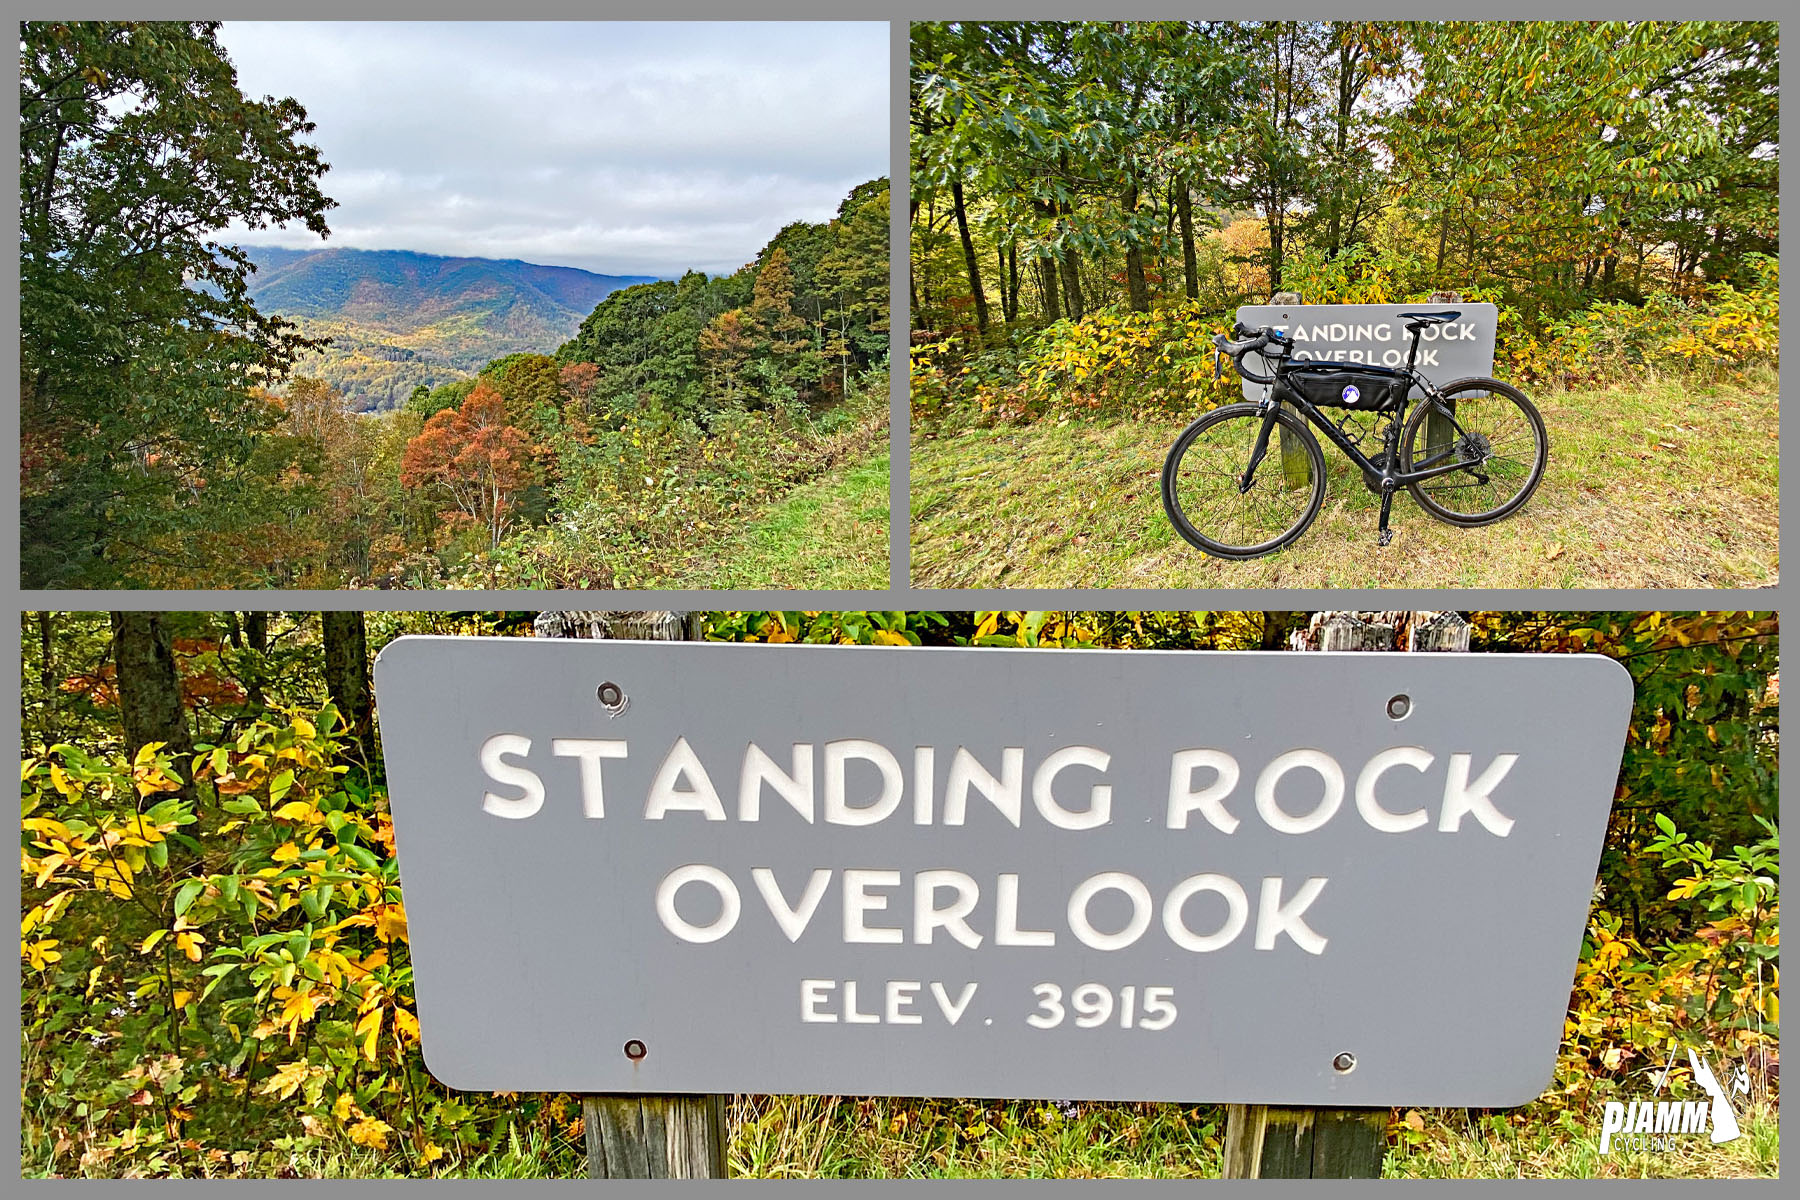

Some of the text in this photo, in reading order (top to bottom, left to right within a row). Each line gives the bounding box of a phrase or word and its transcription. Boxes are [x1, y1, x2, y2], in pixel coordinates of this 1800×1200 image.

[1257, 324, 1392, 342] TANDING
[1293, 349, 1440, 367] OVERLOOK
[481, 734, 1521, 838] STANDING ROCK
[656, 865, 1329, 956] OVERLOOK
[801, 979, 1178, 1031] ELEV. 3915
